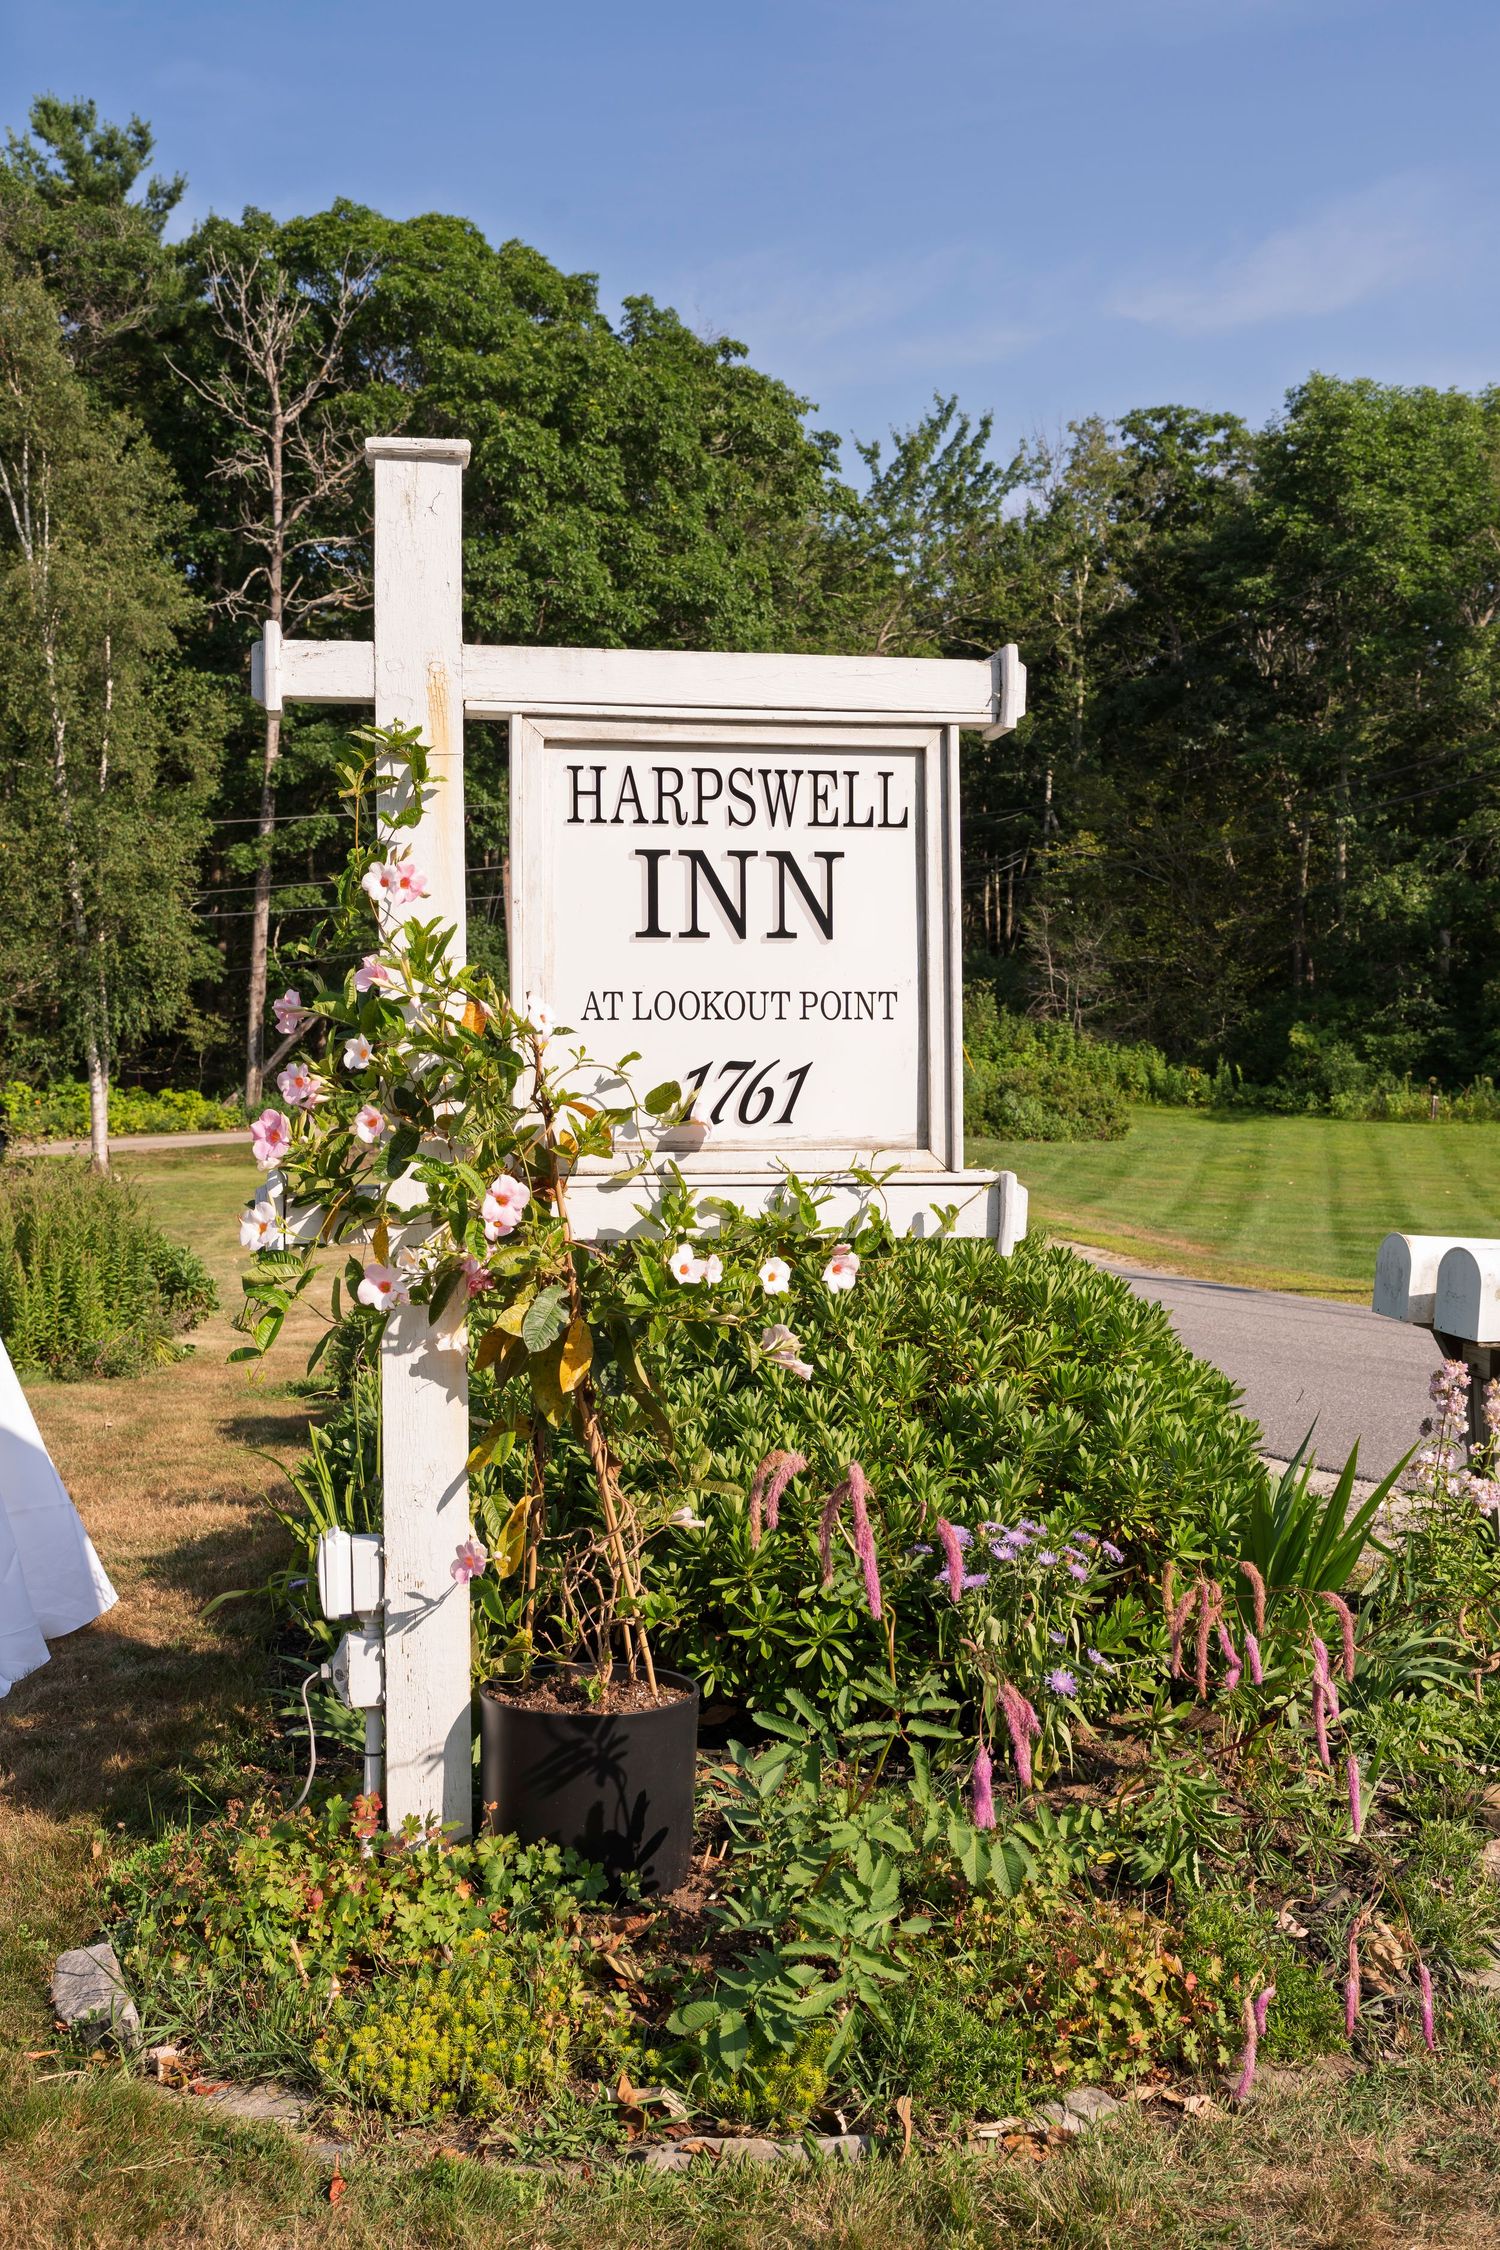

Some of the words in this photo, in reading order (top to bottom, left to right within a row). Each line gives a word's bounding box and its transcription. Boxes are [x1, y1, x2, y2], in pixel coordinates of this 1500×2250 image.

[566, 765, 908, 828] HARPSWELL
[634, 849, 845, 940] INN
[581, 991, 624, 1021] AT
[632, 991, 791, 1021] LOOKOUT
[799, 991, 898, 1021] POINT
[681, 1059, 814, 1125] 1761
